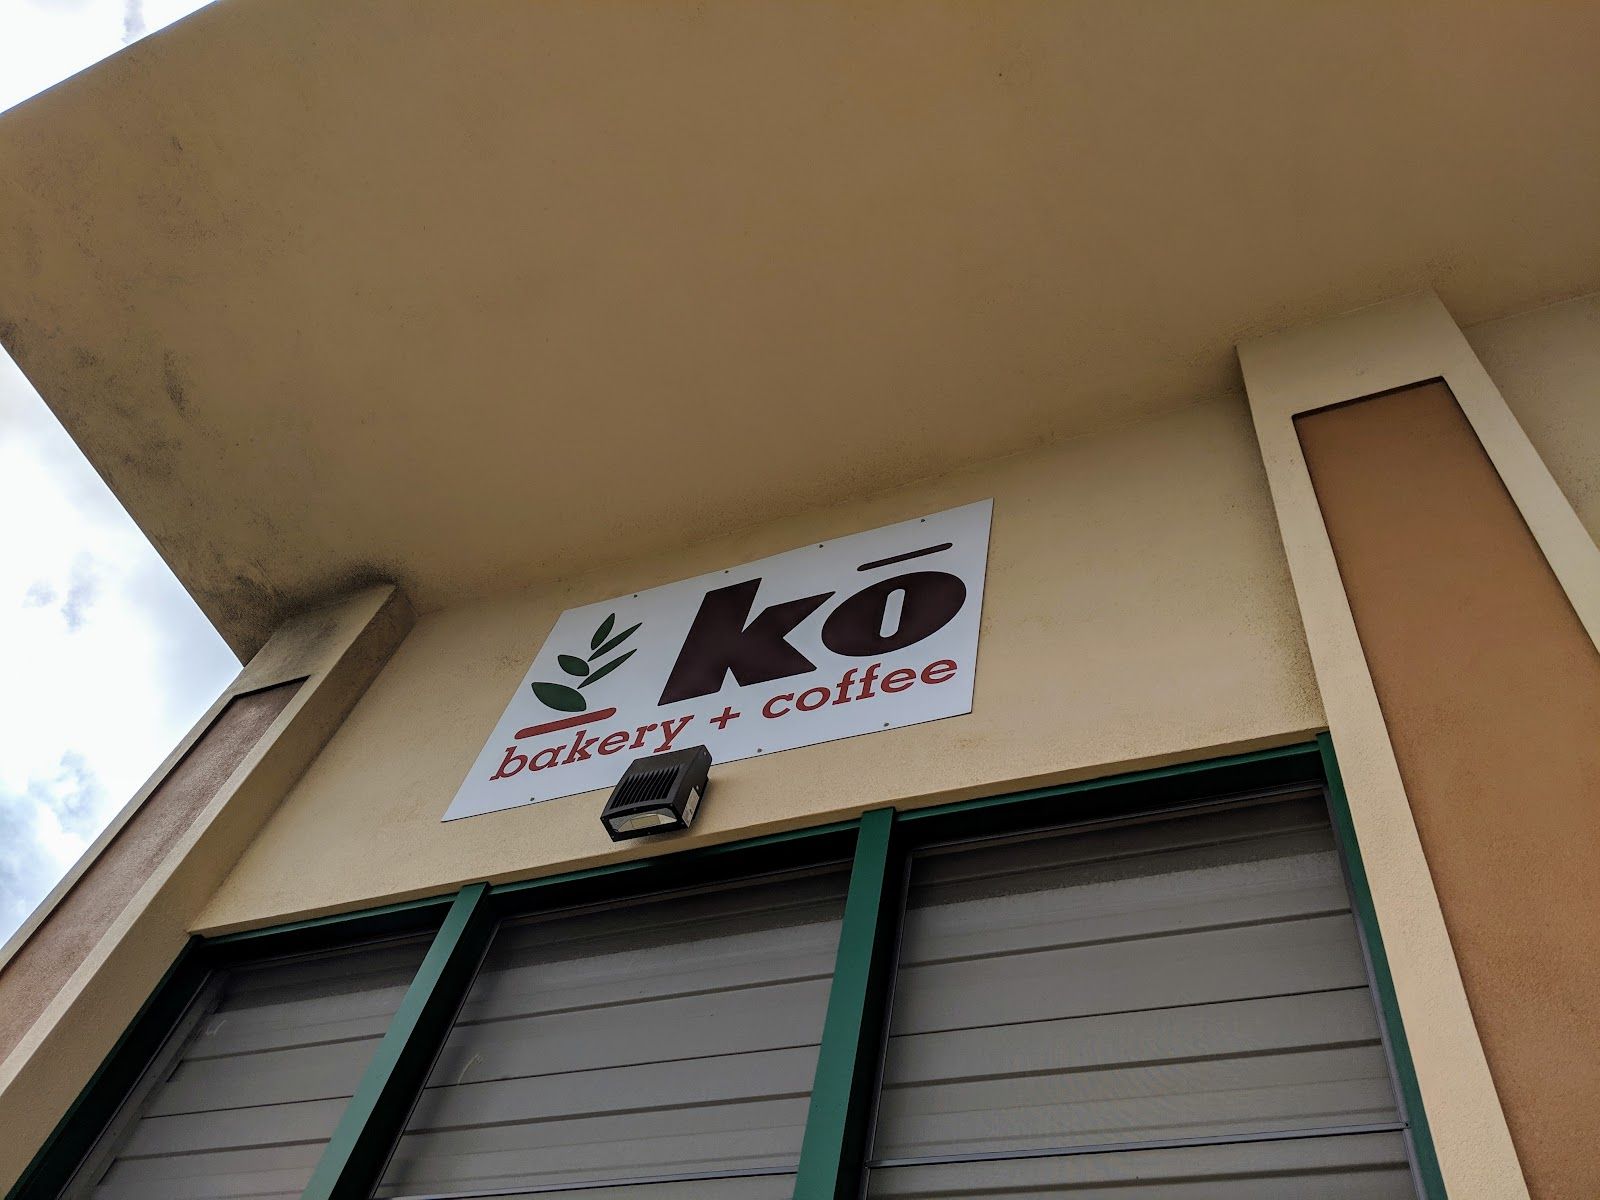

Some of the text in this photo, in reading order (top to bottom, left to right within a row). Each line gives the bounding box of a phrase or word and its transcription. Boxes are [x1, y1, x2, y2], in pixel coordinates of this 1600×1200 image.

[657, 542, 967, 707] kō
[489, 659, 958, 781] bakery + coffee
